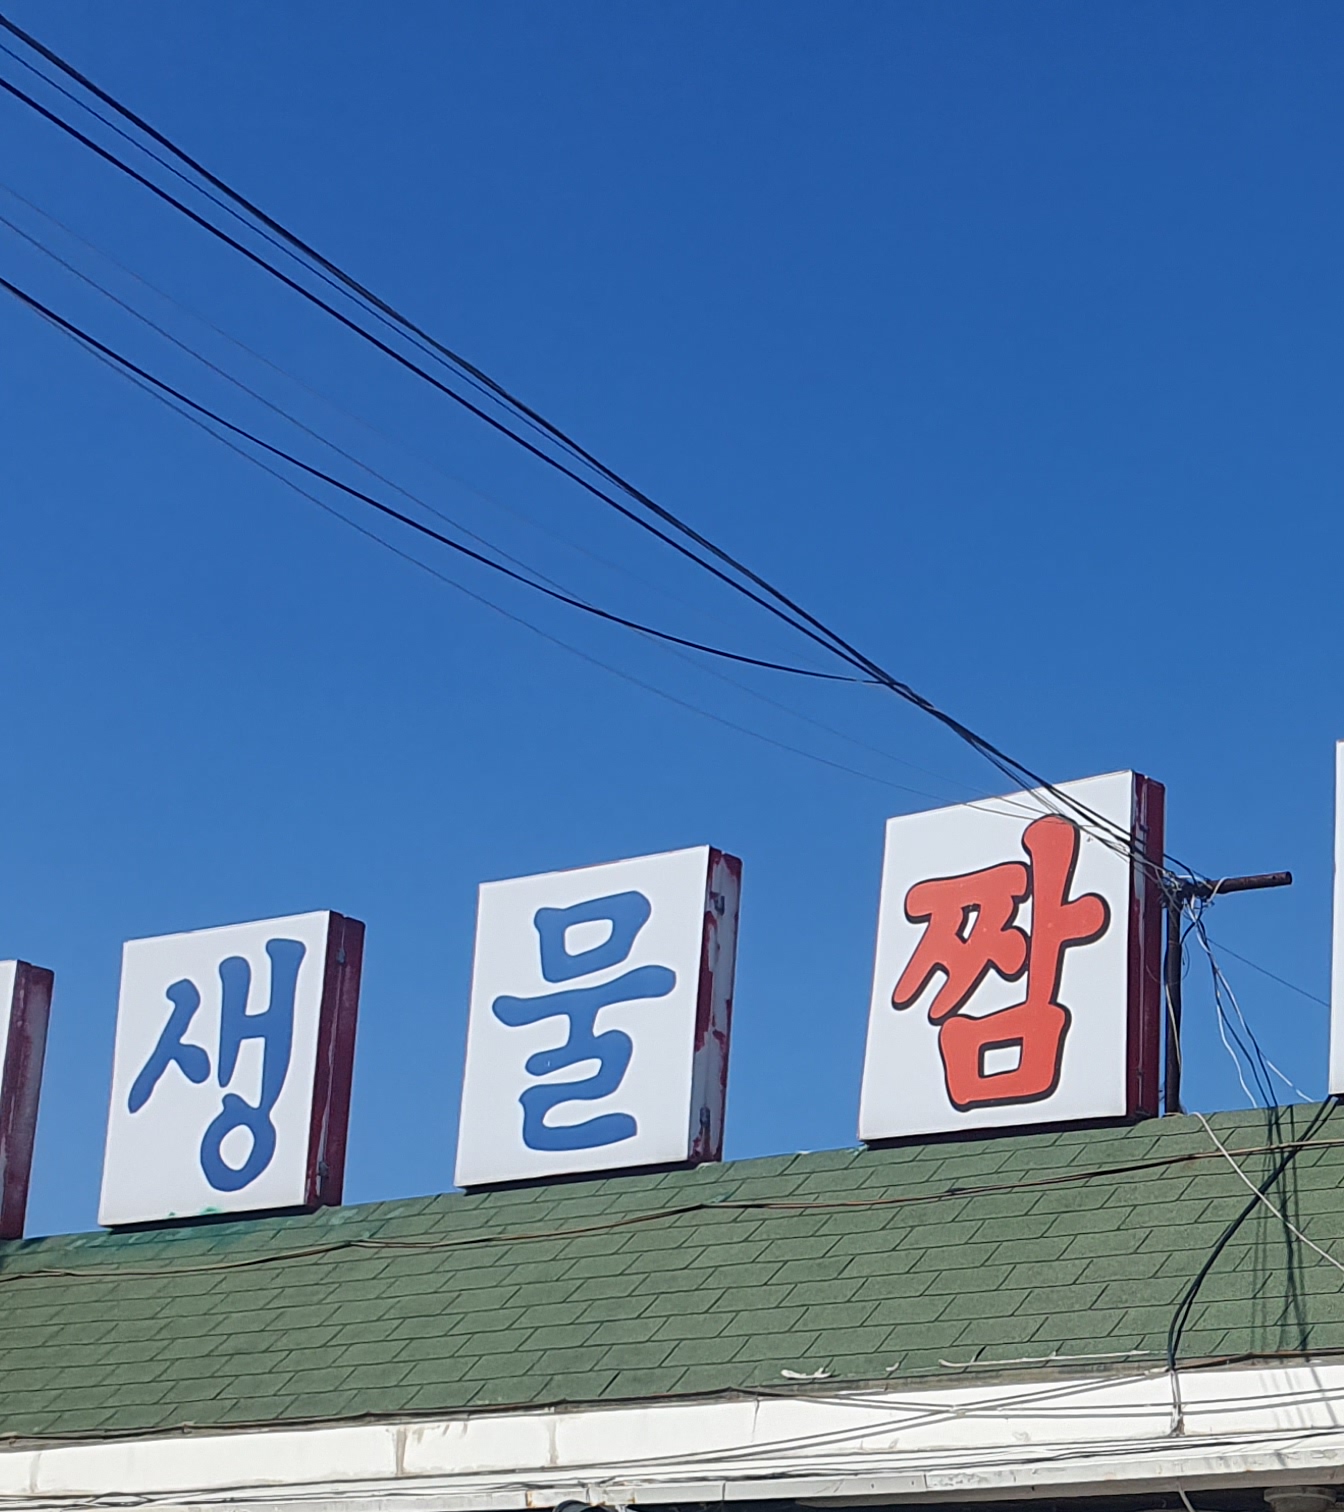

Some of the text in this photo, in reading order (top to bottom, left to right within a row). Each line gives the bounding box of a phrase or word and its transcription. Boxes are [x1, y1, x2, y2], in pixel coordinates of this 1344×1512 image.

[128, 937, 306, 1192] 생
[492, 890, 677, 1151] 물
[891, 814, 1111, 1112] 짬
